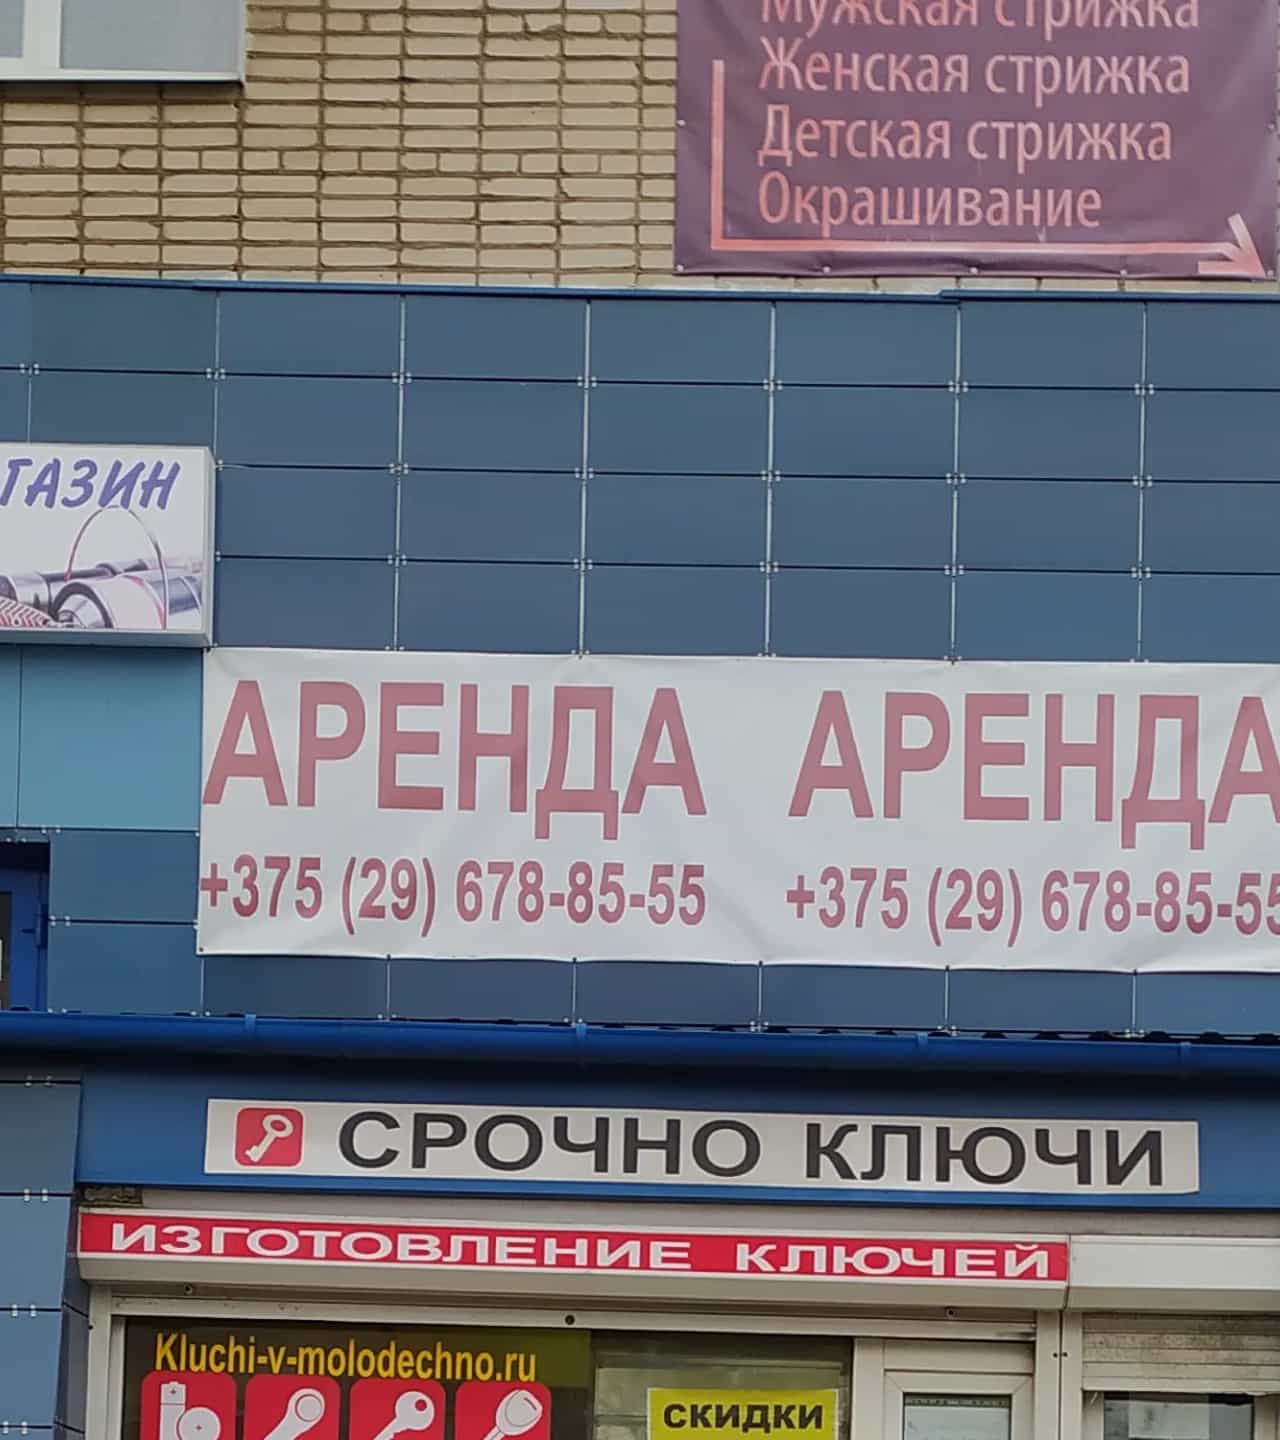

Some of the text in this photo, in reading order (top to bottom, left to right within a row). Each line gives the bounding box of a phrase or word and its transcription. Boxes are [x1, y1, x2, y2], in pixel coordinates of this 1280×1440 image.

[995, 0, 1199, 41] стрижка
[757, 37, 1190, 107] Женская стрижка
[757, 104, 1172, 173] Детская стрижка
[757, 171, 1102, 237] Окрашивание
[202, 680, 706, 840] АРЕНДА
[199, 854, 706, 937] +375 (29) 678-85-55
[786, 865, 908, 930] +375
[927, 867, 1021, 946] (29)
[340, 1110, 1163, 1186] СРОЧНО КЛЮЧИ
[112, 1222, 1049, 1279] ИЗГОТОВЛЕНИЕ КЛЮЧЕЙ
[155, 1333, 537, 1382] Kluchi-v-molodechno.ru
[664, 1404, 823, 1433] СКИДКИ
